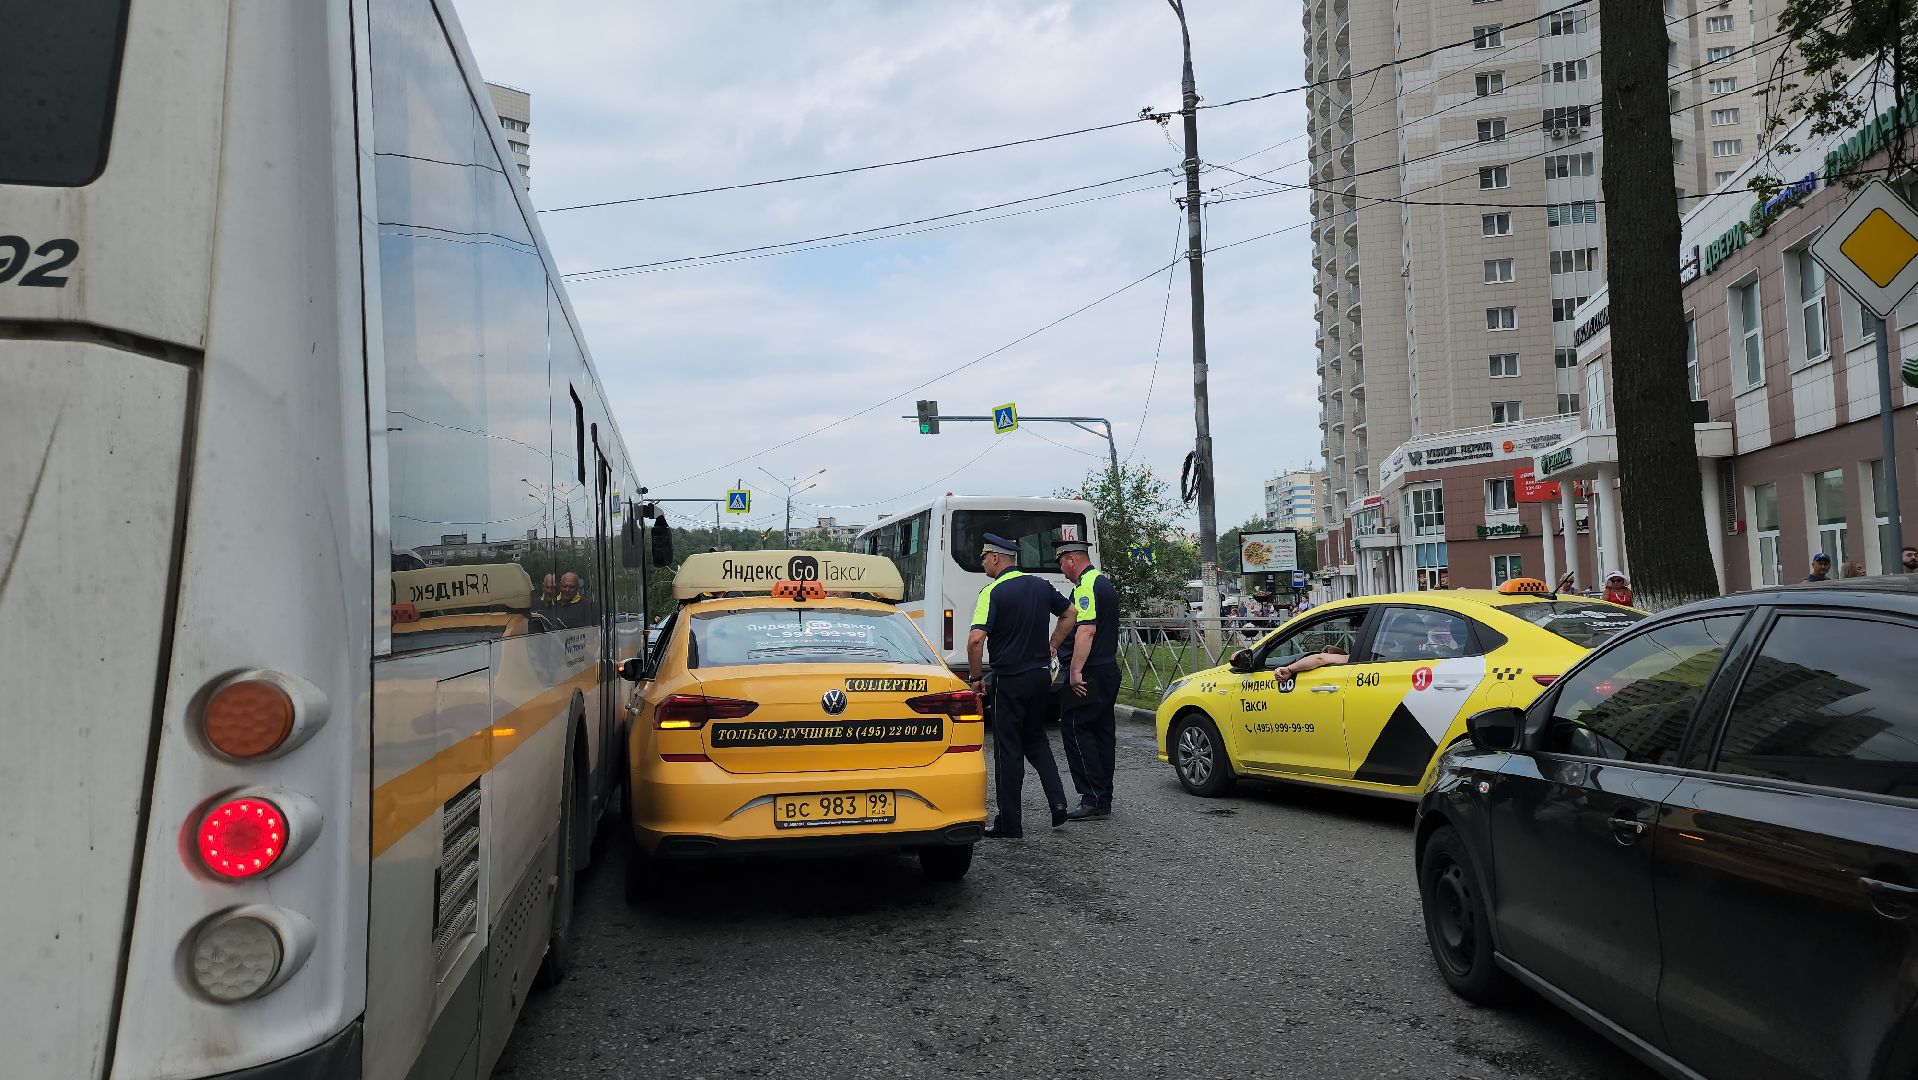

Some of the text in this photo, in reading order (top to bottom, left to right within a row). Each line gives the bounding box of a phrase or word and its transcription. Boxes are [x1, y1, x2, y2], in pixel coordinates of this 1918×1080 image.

[1704, 221, 1747, 275] ДВЕРИ
[1426, 442, 1493, 458] VISION REPAIR
[1063, 527, 1075, 541] 16
[722, 559, 867, 582] Яндекс Go Такси
[846, 679, 927, 691] СОЛЛЕРТИЯ
[1241, 679, 1275, 692] Яндекс
[1356, 672, 1380, 687] 840
[1240, 699, 1267, 712] Такси
[718, 724, 938, 741] ТОЛЬКО ЛУЧШИЕ 8 (495) 22 00 104
[1253, 723, 1315, 733] (495) 999-99-99
[820, 796, 857, 816] 983
[869, 794, 888, 809] 99
